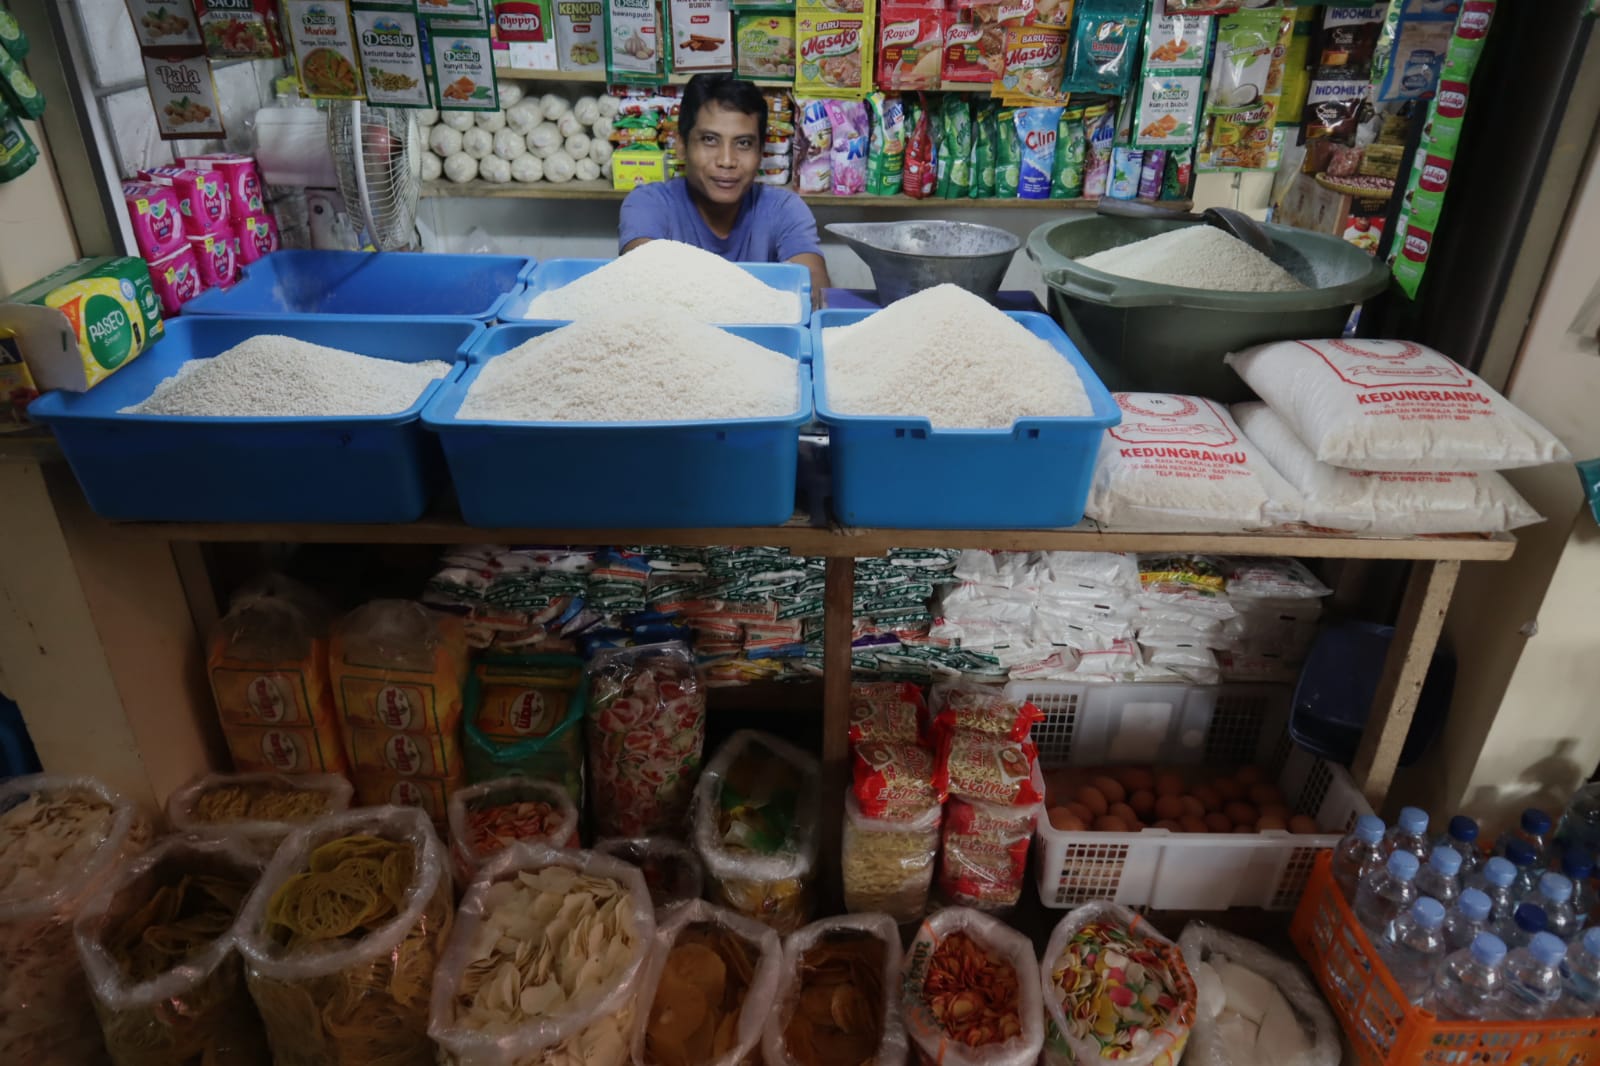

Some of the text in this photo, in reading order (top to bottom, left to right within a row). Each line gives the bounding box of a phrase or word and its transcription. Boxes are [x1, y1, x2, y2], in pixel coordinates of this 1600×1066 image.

[559, 3, 601, 15] KENCUR
[1332, 8, 1382, 19] INDOMILK
[816, 21, 839, 31] BARU
[884, 28, 917, 41] Royco
[362, 29, 415, 50] Desaku
[801, 29, 857, 57] Masako
[1004, 44, 1060, 66] Masako
[156, 65, 200, 86] Pala
[1315, 86, 1366, 96] INDOMILK
[1025, 130, 1056, 150] Clin
[88, 310, 125, 343] PASEO
